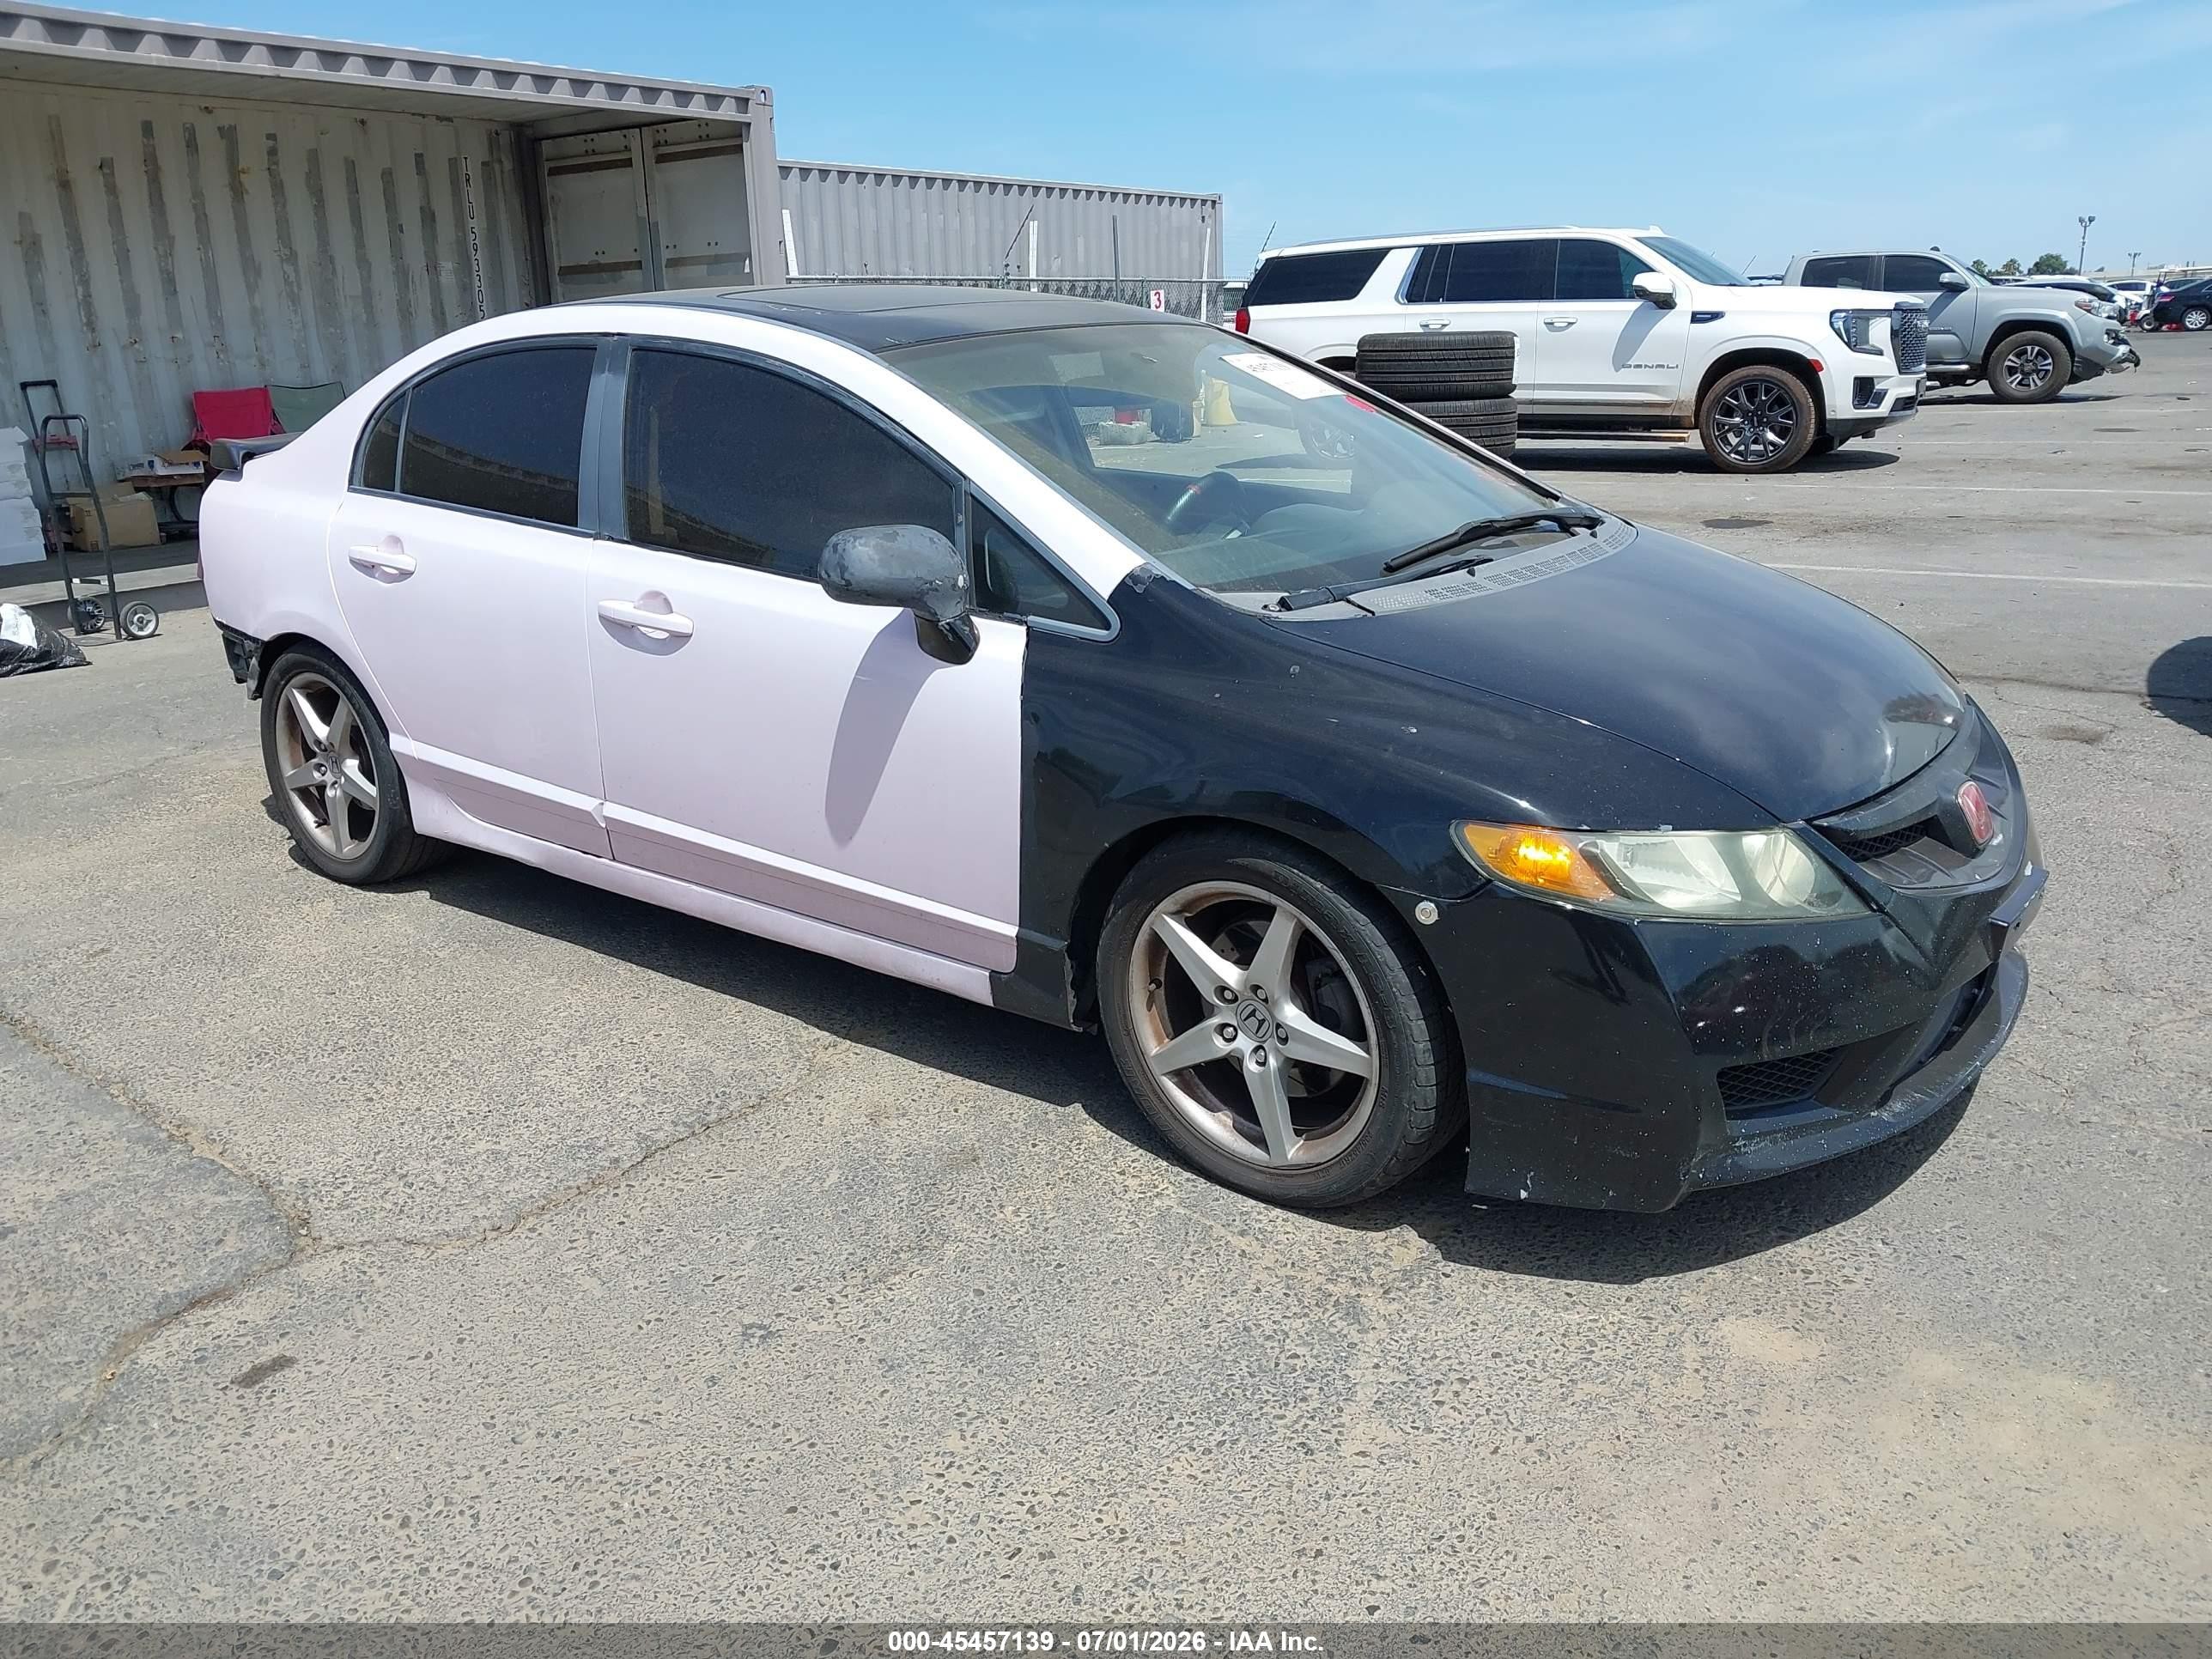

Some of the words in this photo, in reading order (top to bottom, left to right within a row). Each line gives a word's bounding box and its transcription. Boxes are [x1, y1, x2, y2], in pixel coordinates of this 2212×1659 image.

[462, 156, 475, 220] TRLU
[470, 227, 485, 319] 593305
[1153, 291, 1162, 309] 3
